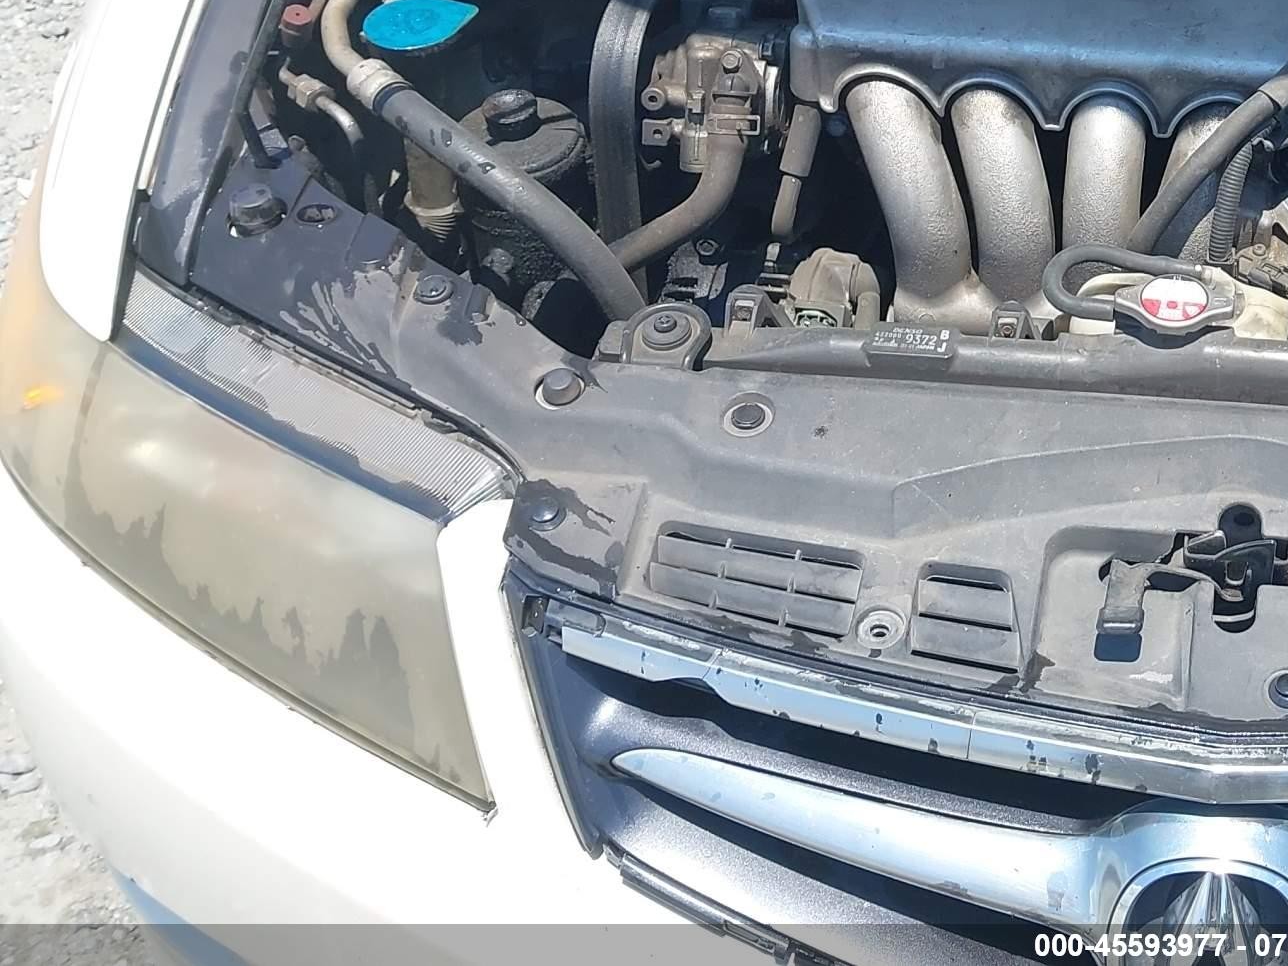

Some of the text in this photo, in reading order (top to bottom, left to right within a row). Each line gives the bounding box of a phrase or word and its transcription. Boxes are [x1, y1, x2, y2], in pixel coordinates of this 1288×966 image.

[905, 334, 937, 346] 9372
[940, 329, 950, 340] B
[936, 342, 947, 352] J
